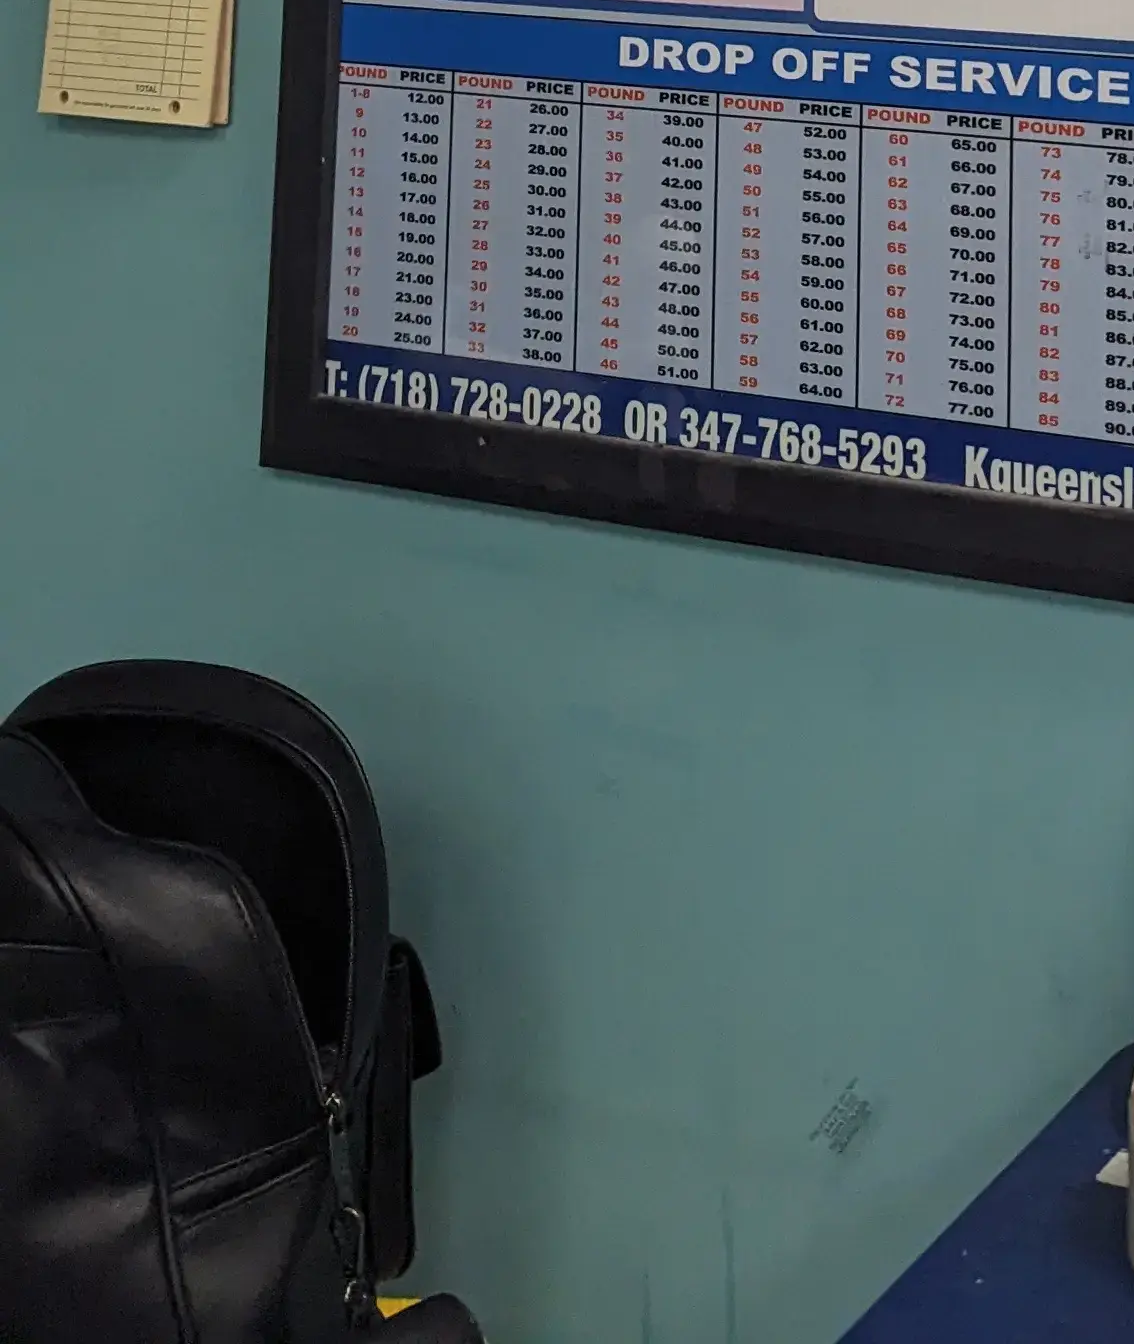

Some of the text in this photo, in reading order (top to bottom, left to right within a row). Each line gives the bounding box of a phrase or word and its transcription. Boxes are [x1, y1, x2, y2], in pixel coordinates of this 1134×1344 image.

[400, 70, 710, 107] PRICE POUND PRICE POUND PRICE
[618, 35, 1131, 106] DROP OFF SERVICE
[358, 365, 439, 412] (718)
[451, 377, 602, 435] 728-0228
[624, 400, 667, 445] OR
[679, 405, 926, 482] 347-768-5293
